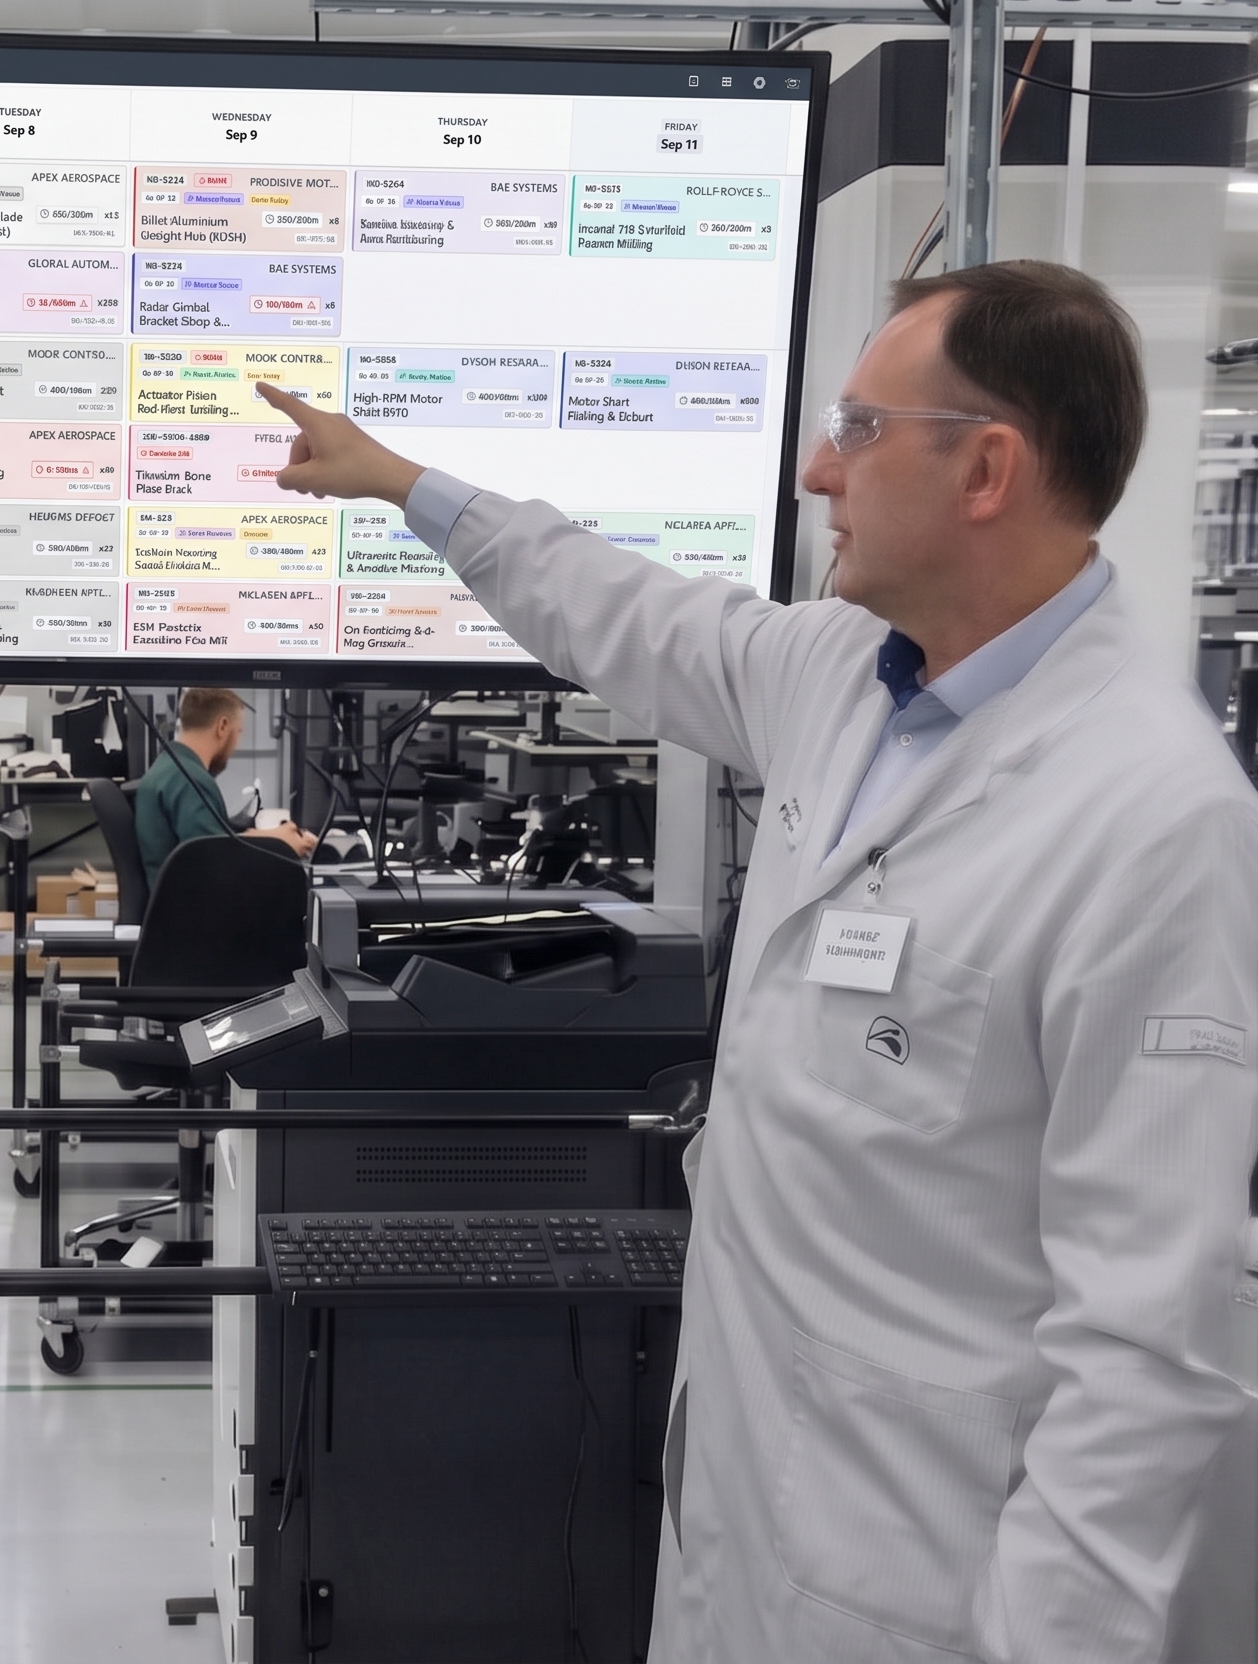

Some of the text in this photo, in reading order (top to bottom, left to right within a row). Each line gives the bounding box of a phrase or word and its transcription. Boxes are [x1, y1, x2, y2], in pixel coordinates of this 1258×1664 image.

[211, 112, 272, 123] WEDNESDAY
[437, 116, 488, 127] THURSDAY
[3, 124, 35, 138] Sep 8
[664, 122, 698, 132] FRIDAY
[225, 129, 258, 143] Sep 9
[442, 133, 482, 148] Sep 10
[660, 137, 698, 151] Sep 11
[31, 173, 121, 183] APEX AEROSPACE
[250, 177, 302, 188] PRODISIVE
[491, 183, 558, 193] BAE SYSTEMS
[142, 215, 168, 225] Billet
[619, 225, 635, 234] 718
[28, 259, 69, 268] GLORAL
[269, 264, 337, 274] BAE SYSTEMS
[140, 302, 210, 312] Radar Gimbal
[139, 316, 178, 326] Bracket
[214, 317, 230, 327] &...
[246, 354, 277, 363] MOOK
[354, 393, 443, 405] High-RPM Motor
[608, 411, 615, 421] &
[29, 431, 116, 441] APEX AEROSPACE
[185, 471, 211, 480] Bone
[137, 484, 162, 493] Plase
[241, 515, 328, 525] APEX AEROSPACE
[347, 564, 354, 572] &
[133, 623, 155, 631] ESM
[344, 626, 360, 634] On
[344, 639, 365, 650] Mag
